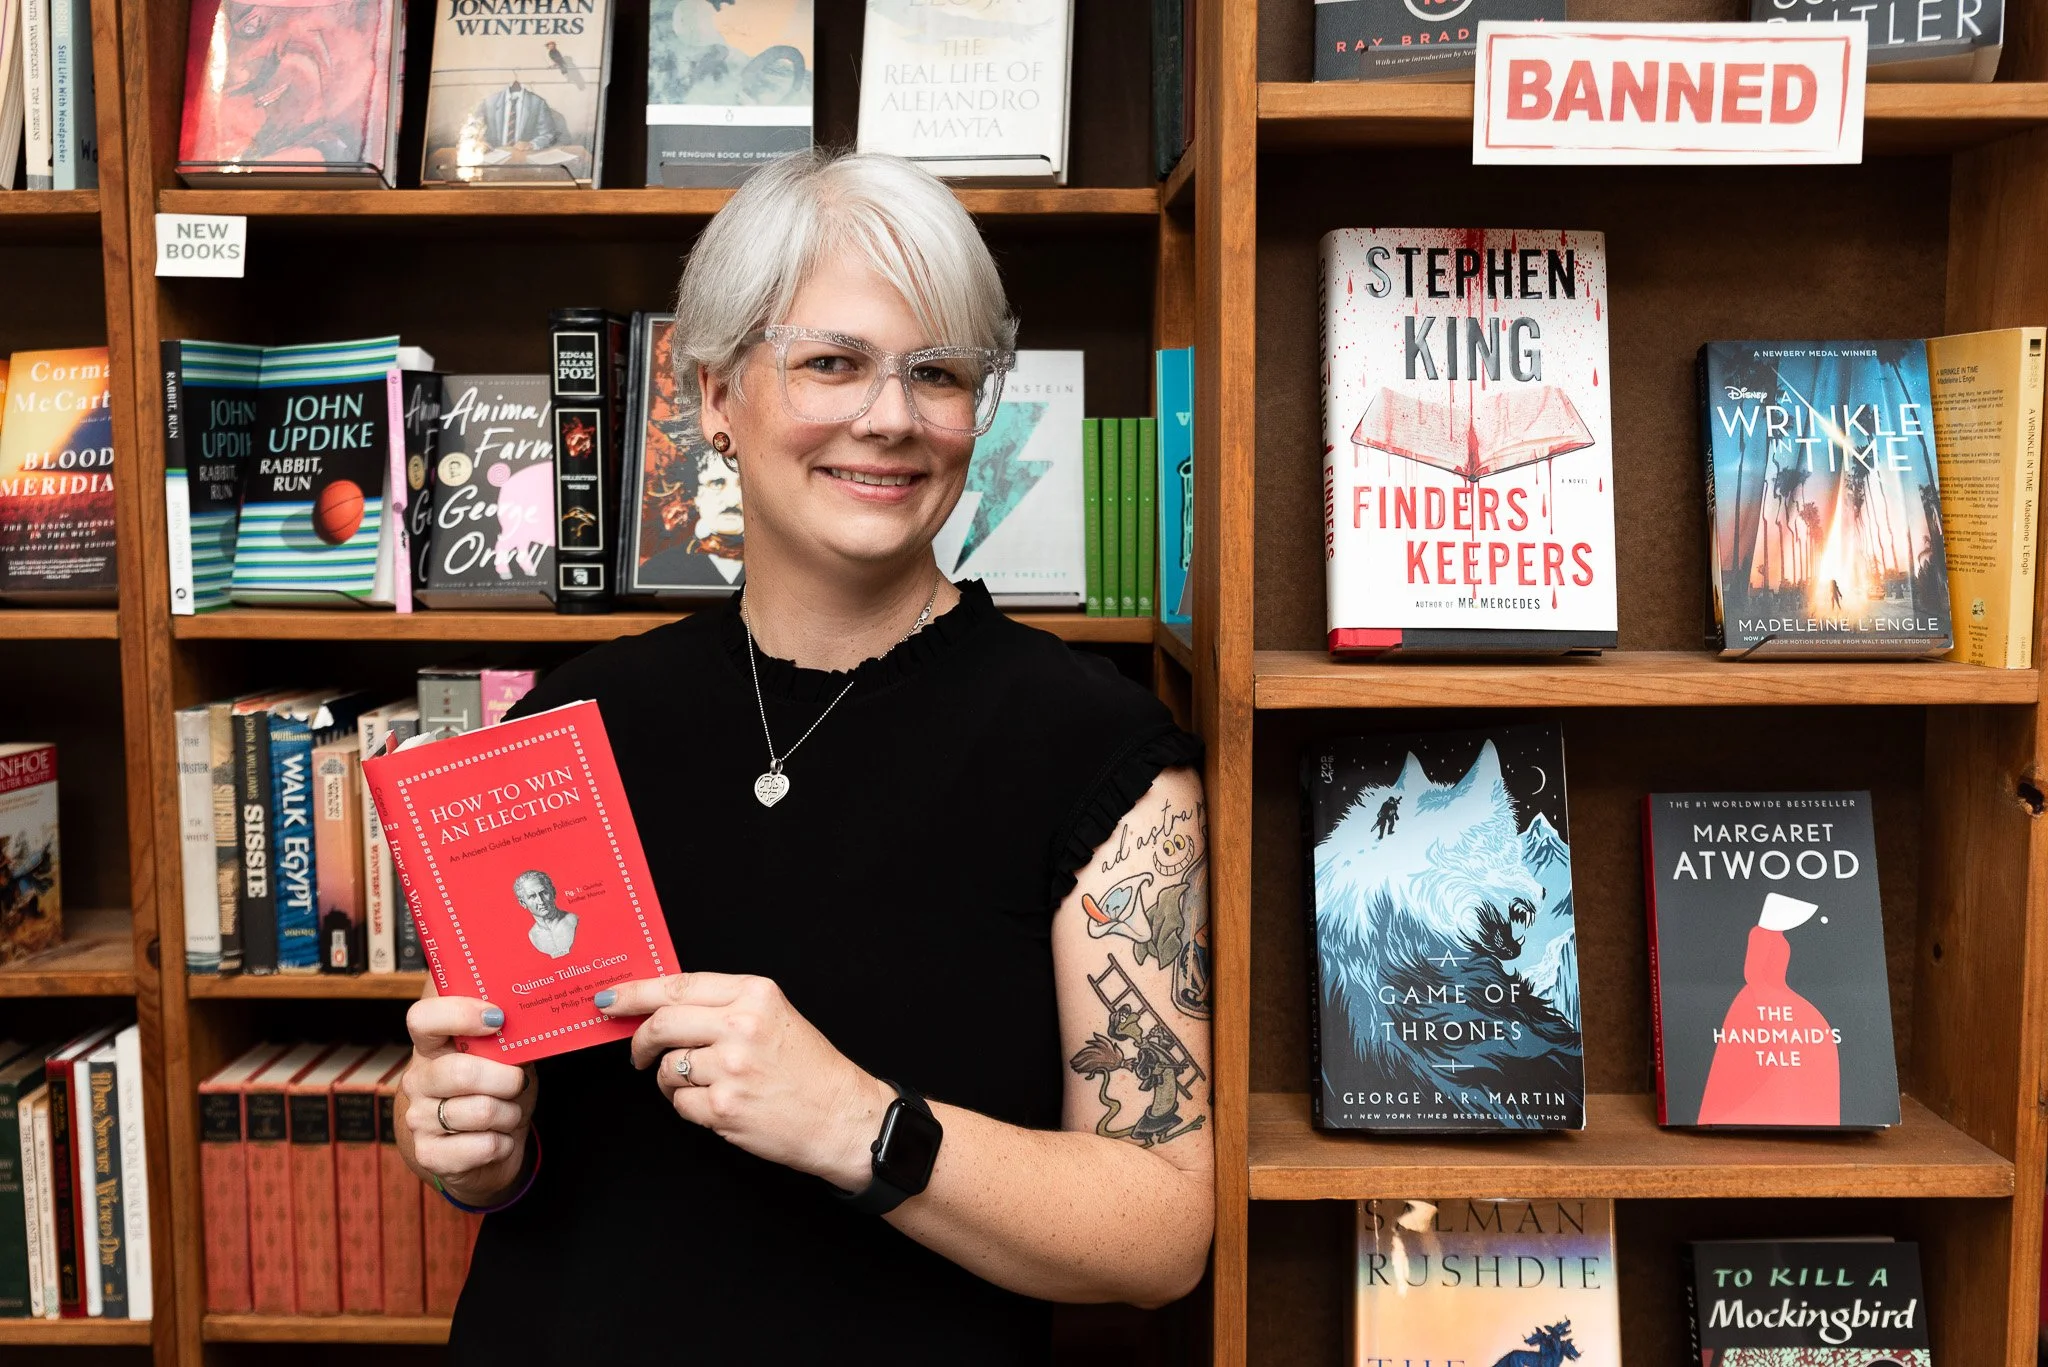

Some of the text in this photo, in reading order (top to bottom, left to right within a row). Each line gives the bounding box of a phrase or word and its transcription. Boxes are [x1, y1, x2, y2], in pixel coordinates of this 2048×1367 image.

[448, 0, 594, 20] JONATHAN
[456, 17, 584, 36] WINTERS
[943, 38, 984, 56] THE
[1336, 37, 1383, 52] RAY
[884, 61, 1044, 85] REAL LIFE OF
[881, 89, 1040, 112] ALEJANDRO
[1507, 59, 1816, 125] BANNED
[56, 45, 68, 163] Still Life With Woodpecker
[913, 117, 1003, 139] MAYTA
[177, 223, 229, 239] NEW
[166, 243, 240, 260] BOOKS
[1366, 246, 1576, 300] STEPHEN
[559, 351, 594, 360] EDGAR
[1405, 315, 1542, 382] KING
[1841, 349, 1878, 357] WINNER
[558, 366, 596, 381] POE
[559, 359, 594, 368] ALLAN
[1780, 390, 1792, 403] A
[283, 393, 364, 426] JOHN
[440, 386, 551, 436] Animal
[1717, 403, 1924, 438] WRINKLE
[168, 413, 178, 439] RUN
[268, 422, 374, 453] UPDIKE
[2027, 417, 2036, 457] WRINKLE
[473, 427, 554, 468] Farm
[1771, 439, 1793, 454] IN
[1795, 437, 1913, 472] TIME
[24, 447, 115, 471] BLOOD
[259, 457, 323, 476] RABBIT,
[2027, 460, 2034, 469] IN
[210, 484, 233, 500] RUN
[272, 475, 312, 493] RUN
[2025, 470, 2033, 491] TIME
[438, 484, 540, 541] George
[1324, 465, 1336, 562] FINDERS
[1353, 486, 1529, 532] FINDERS
[2023, 499, 2032, 541] Madeleine
[443, 531, 549, 575] Orwell
[1406, 540, 1594, 587] KEEPERS
[974, 571, 1068, 579] MARY SHELLEY
[1415, 601, 1444, 609] AUTHOR
[1480, 597, 1541, 610] MERCEDES
[1738, 617, 1940, 632] MADELEINE L'ENGLE
[244, 715, 256, 744] JOHN
[429, 766, 573, 824] HOW TO WIN
[1669, 801, 1690, 809] THE
[1712, 800, 1782, 808] WORLDWIDE
[1787, 800, 1856, 808] BESTSELLER
[440, 787, 581, 845] AN ELECTION
[280, 753, 313, 915] WALK EGYPT
[450, 815, 588, 863] An Ancient Guide for Modern Politicians
[1101, 798, 1193, 874] ad astra
[1693, 824, 1834, 843] MARGARET
[244, 804, 268, 898] SISSIE
[1673, 850, 1860, 880] ATWOOD
[375, 787, 449, 989] Cicero How to Win an Election
[512, 953, 628, 995] Quintus Tullius Cicero
[519, 995, 554, 1011] Translated
[554, 991, 567, 1000] and
[569, 985, 583, 996] with
[595, 971, 634, 988] introduction
[1378, 983, 1522, 1005] GAME OF
[551, 998, 580, 1014] by Philip
[1757, 1006, 1793, 1022] THE
[1381, 1021, 1522, 1042] THRONES
[1713, 1028, 1842, 1045] HANDMAID'S
[1755, 1051, 1802, 1068] TALE
[1343, 1091, 1566, 1106] GEORGE MARTIN
[1527, 1114, 1567, 1122] AUTHOR
[1367, 1253, 1601, 1290] RUSHDIE
[1713, 1267, 1888, 1288] TO KILL A
[1708, 1297, 1918, 1345] Mockingbird
